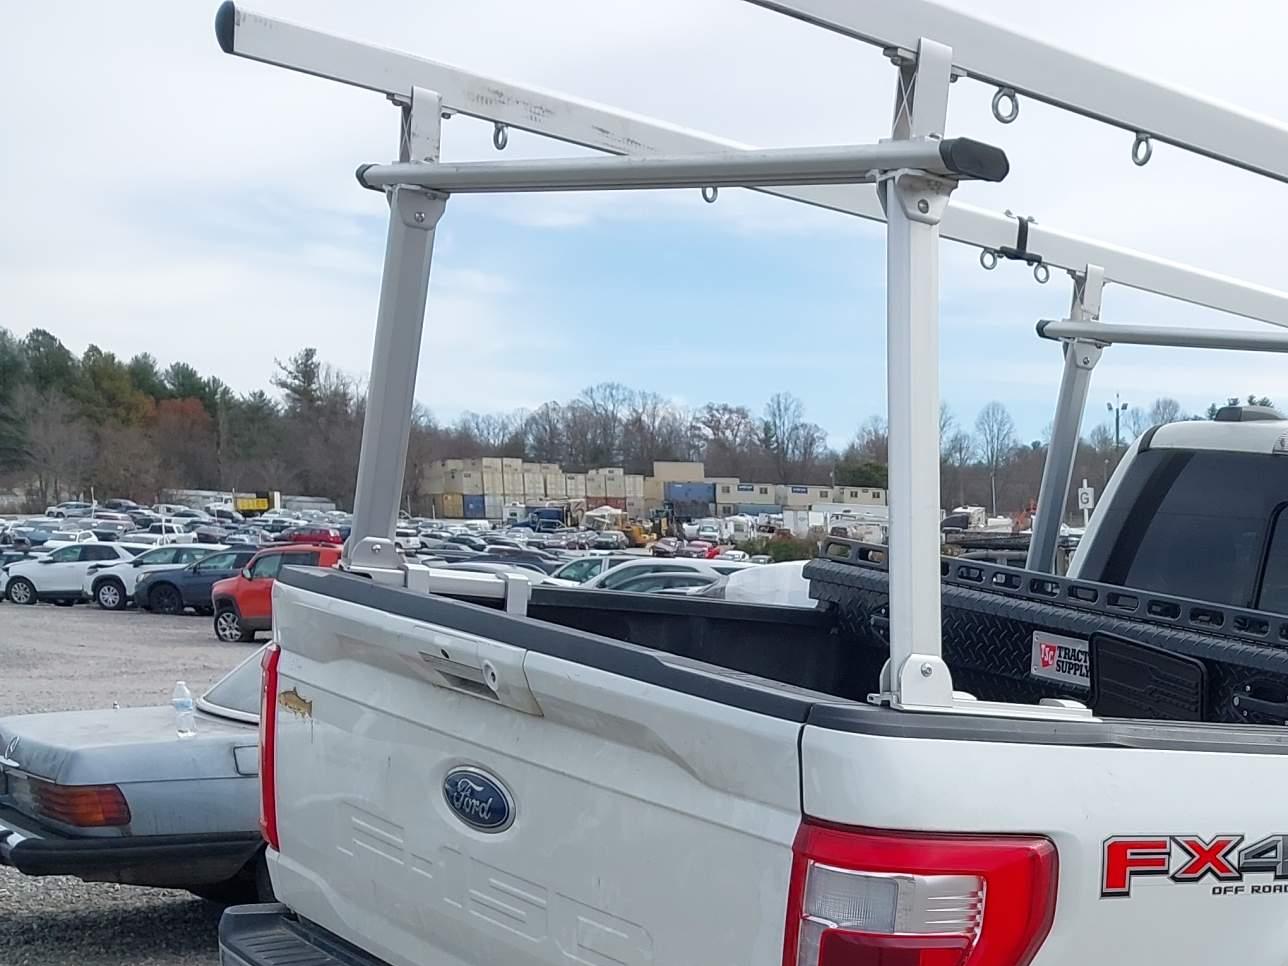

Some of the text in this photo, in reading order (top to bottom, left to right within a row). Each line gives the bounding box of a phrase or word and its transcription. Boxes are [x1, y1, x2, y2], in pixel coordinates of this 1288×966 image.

[1080, 491, 1090, 505] G
[1056, 660, 1090, 678] SUPPLY
[453, 778, 494, 820] Ford
[1212, 885, 1245, 895] OFF
